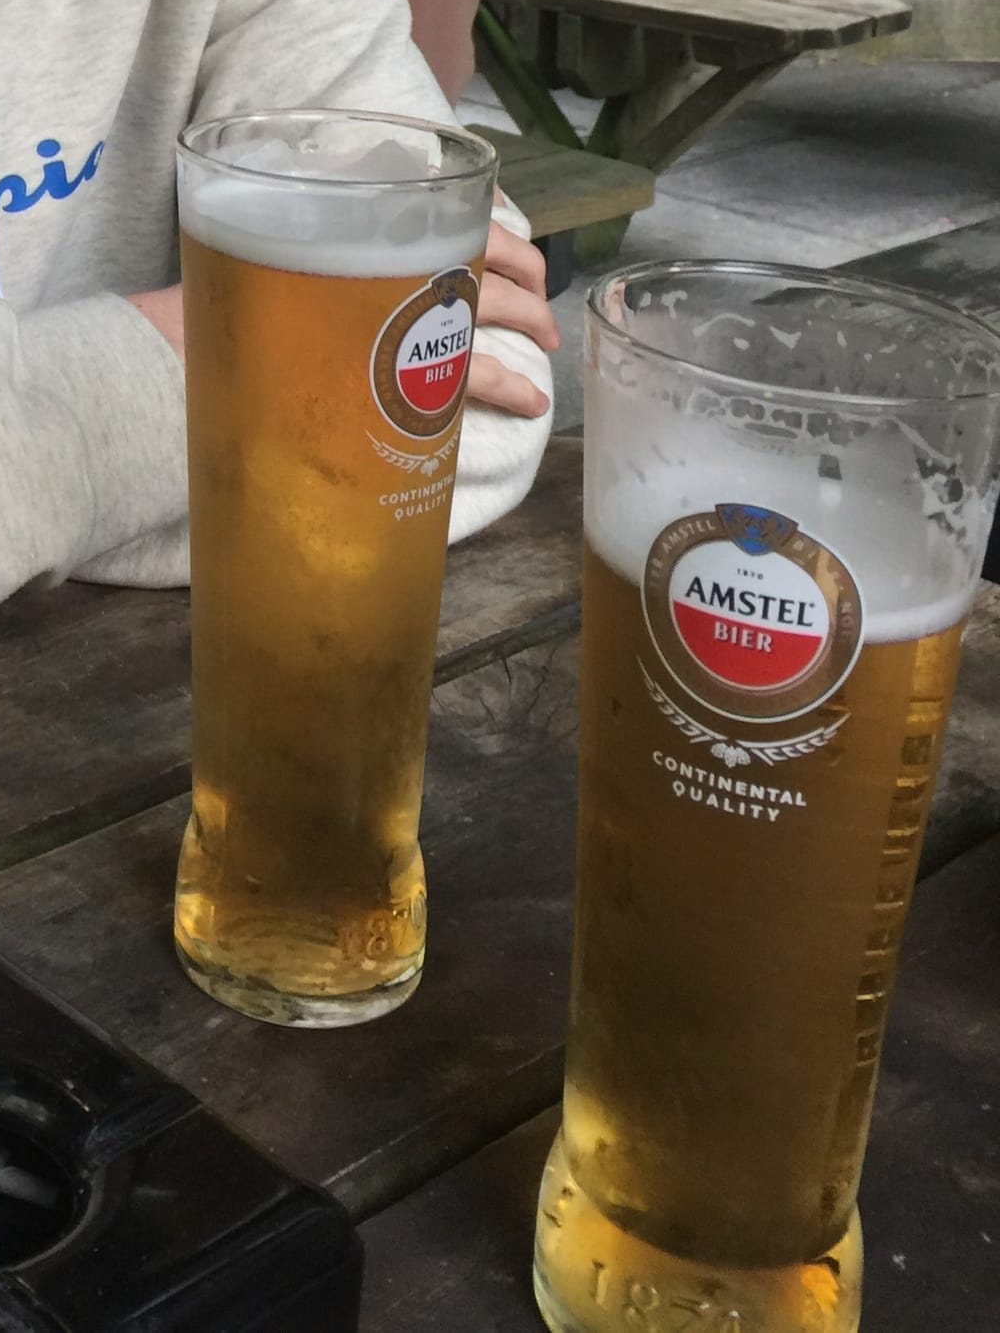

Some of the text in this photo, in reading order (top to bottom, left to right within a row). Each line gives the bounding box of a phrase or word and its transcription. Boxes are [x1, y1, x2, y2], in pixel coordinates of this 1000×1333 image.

[408, 327, 469, 363] AMSTEL
[425, 363, 454, 384] BIER
[394, 493, 447, 522] QUALITY
[685, 577, 814, 628] AMSTEL
[713, 621, 773, 653] BIER
[652, 750, 807, 807] CONTINENTAL
[672, 781, 781, 822] QUALITY
